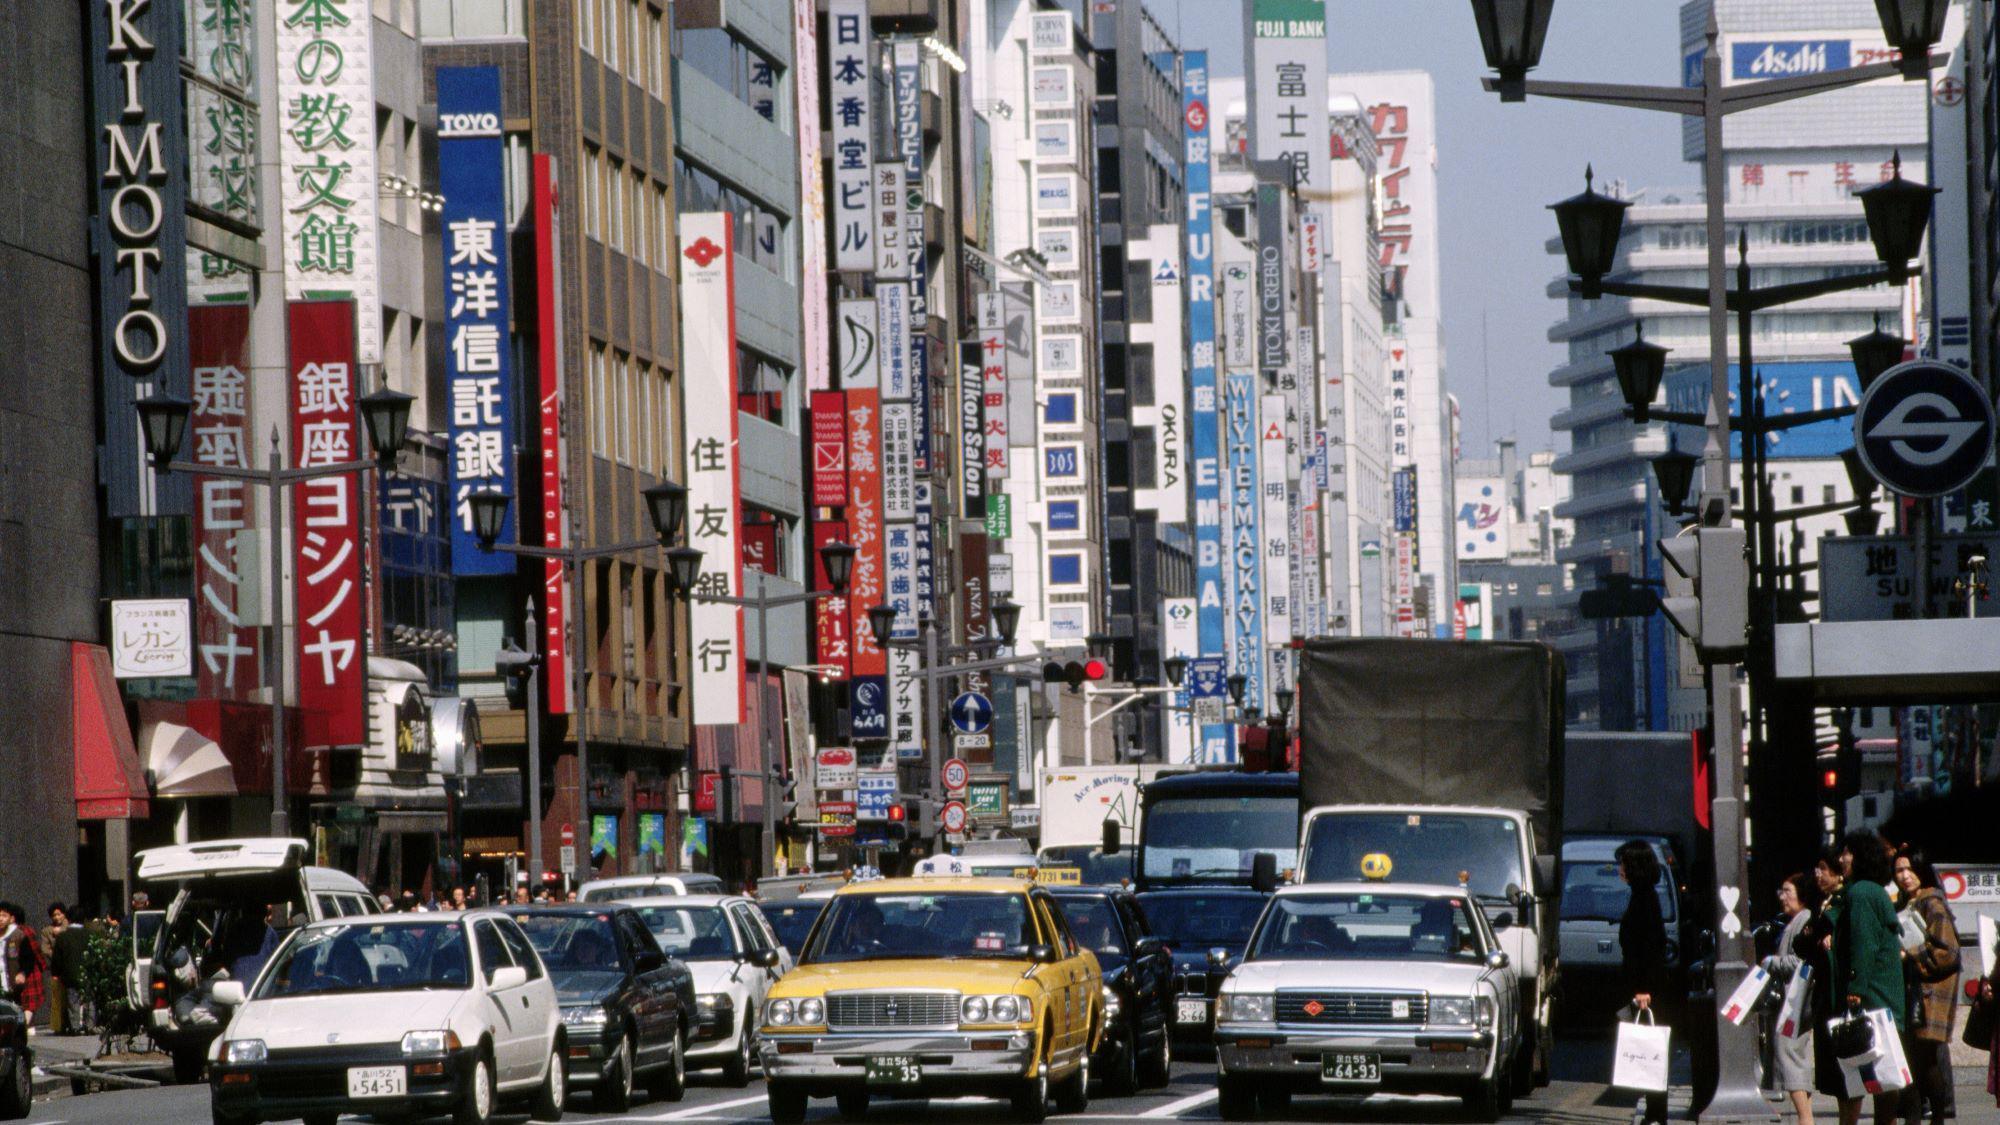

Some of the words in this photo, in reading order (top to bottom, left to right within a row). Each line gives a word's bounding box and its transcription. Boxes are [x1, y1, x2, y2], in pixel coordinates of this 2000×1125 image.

[1255, 20, 1285, 37] FUJI
[1290, 20, 1325, 37] BANK
[1751, 43, 1827, 74] Asahi
[286, 0, 358, 273] 本の教文館
[440, 113, 498, 131] TOYO
[834, 14, 868, 252] 日本香堂ビル
[880, 170, 898, 269] 池田屋ビル
[1188, 193, 1214, 301] FUR
[1262, 245, 1281, 312] CREBIO
[448, 217, 505, 532] 東洋信託銀行
[1192, 340, 1215, 412] 銀座
[1265, 316, 1282, 365] ITOKI
[963, 363, 982, 427] Nikon
[983, 336, 1008, 469] 千代田火災
[964, 428, 984, 498] Salon
[1161, 403, 1179, 489] OKURA
[543, 405, 559, 565] SUMITOMO
[297, 362, 356, 685] 銀座ヨシノヤ
[690, 437, 731, 673] 住友銀行
[1195, 457, 1221, 608] EMBA
[1265, 481, 1289, 616] 明治屋
[889, 528, 911, 616] 高梨歯科
[123, 630, 182, 649] レカン
[547, 586, 560, 657] BANK
[853, 713, 886, 729] らん月
[948, 768, 964, 782] 50
[1073, 783, 1093, 804] Ace
[1092, 773, 1131, 790] Moving
[1967, 888, 1993, 896] Ginza
[361, 1079, 401, 1095] 54-51
[1335, 1064, 1377, 1079] 64-93
